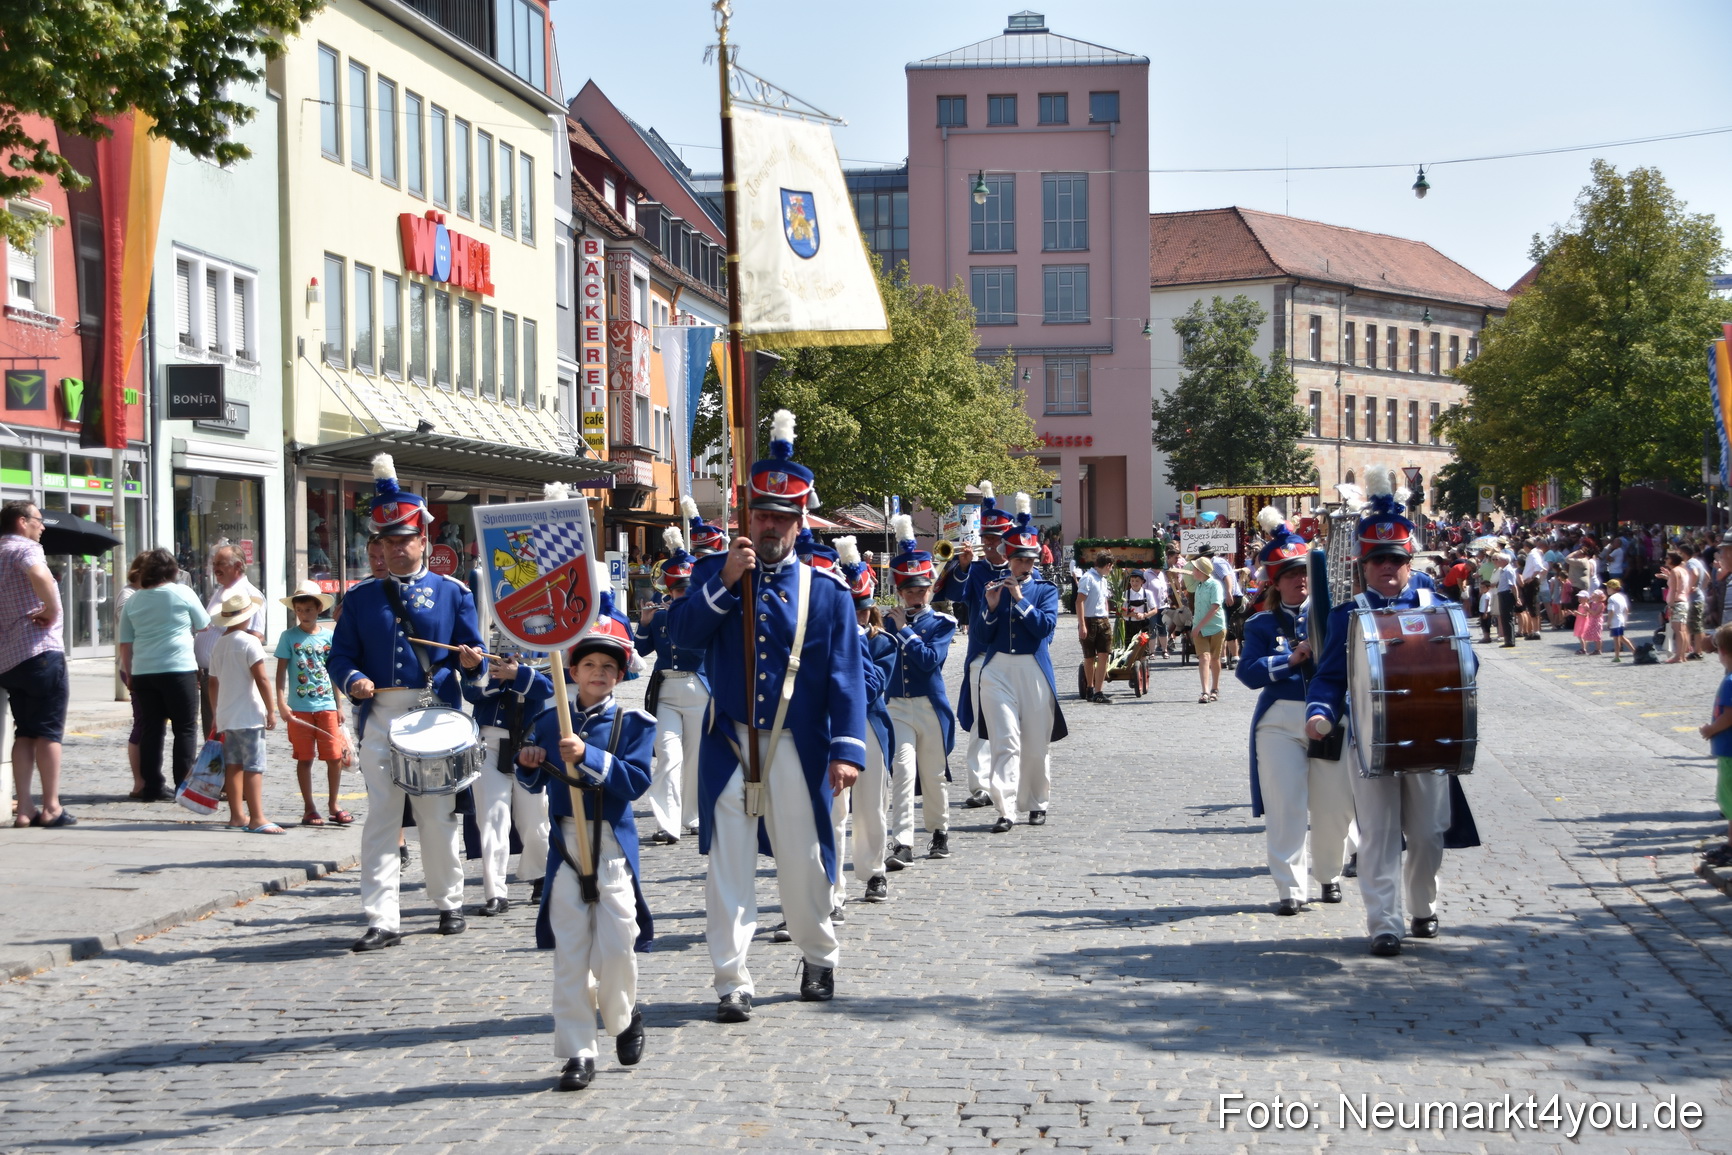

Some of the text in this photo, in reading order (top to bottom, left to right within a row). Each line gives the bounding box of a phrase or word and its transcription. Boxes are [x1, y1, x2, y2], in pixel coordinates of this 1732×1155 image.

[398, 210, 495, 297] WÖHRL
[584, 240, 600, 406] BÄCKEREI
[584, 413, 604, 426] café
[430, 555, 451, 565] 25%
